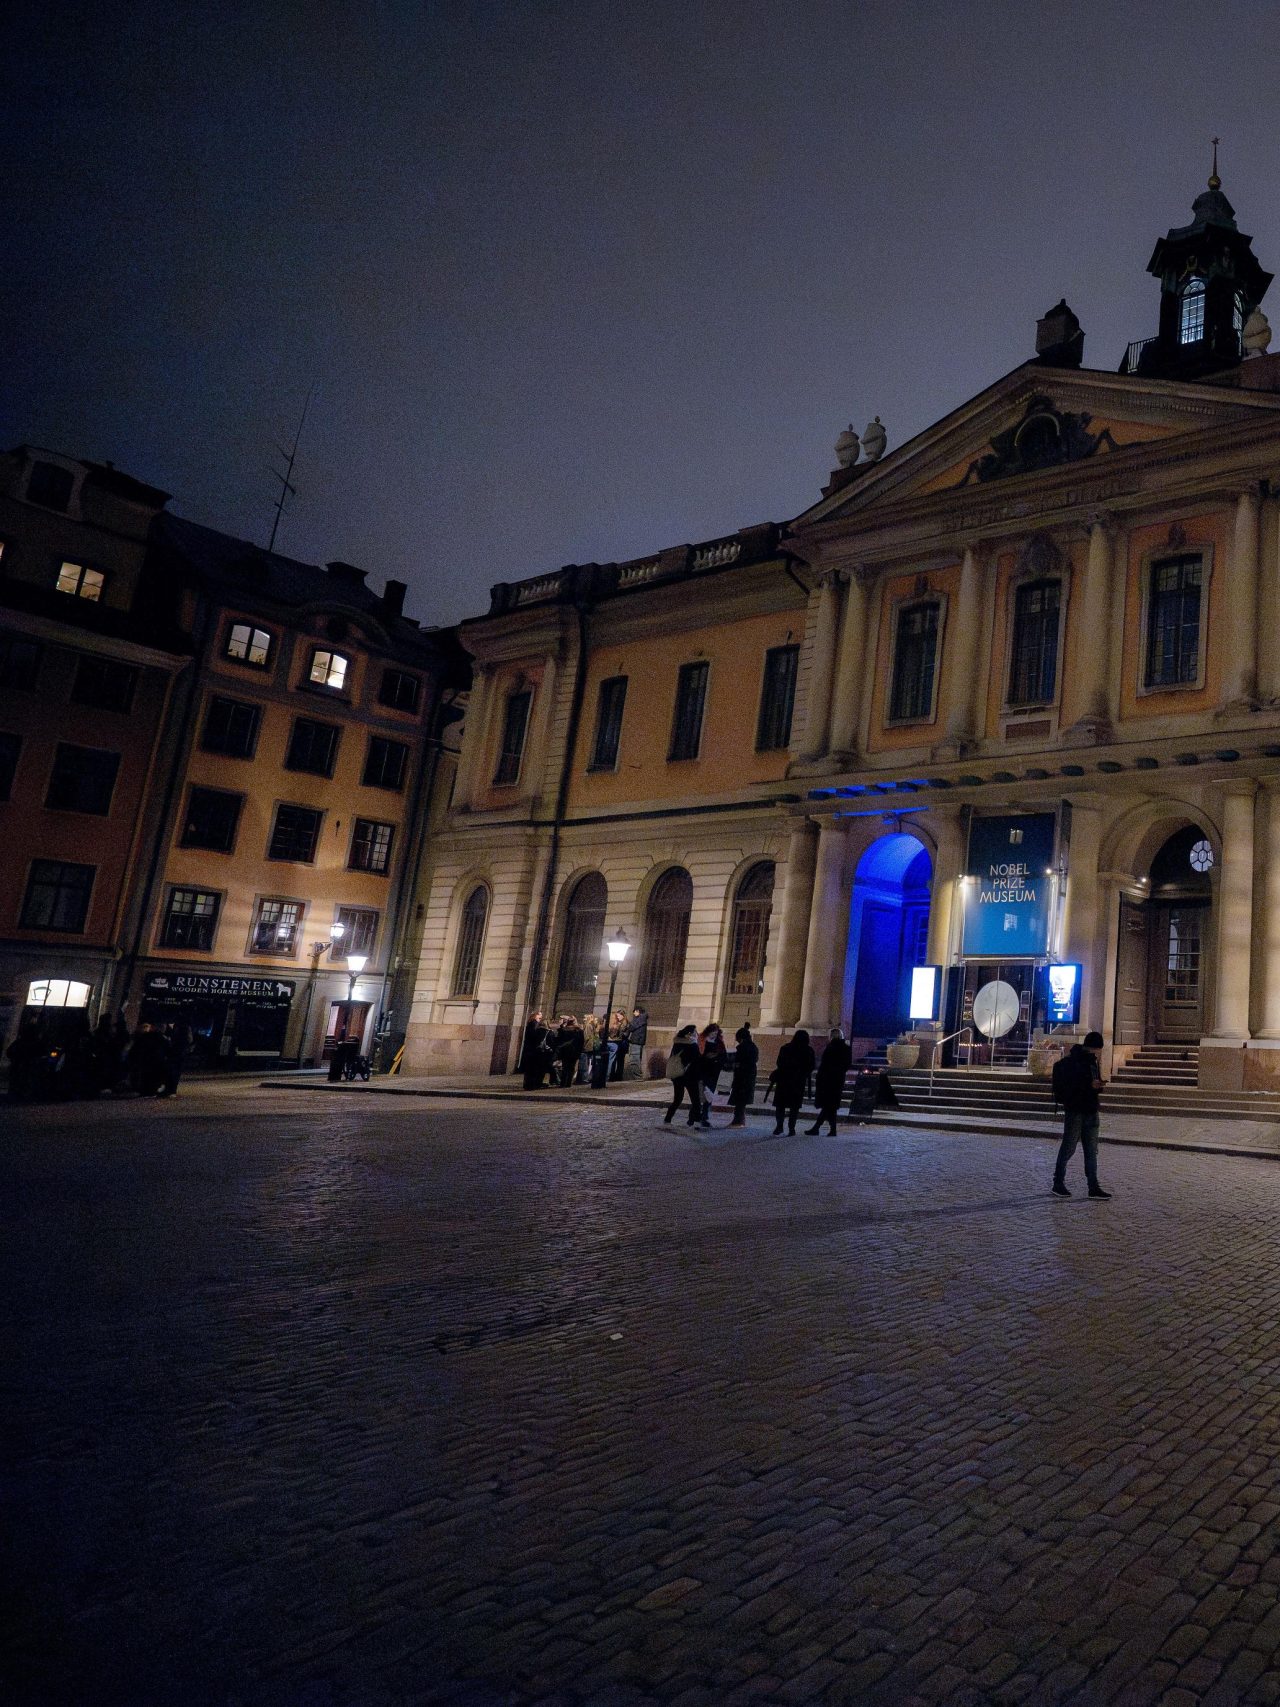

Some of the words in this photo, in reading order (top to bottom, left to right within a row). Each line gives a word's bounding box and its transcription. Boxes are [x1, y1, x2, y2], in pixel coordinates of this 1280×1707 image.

[990, 863, 1031, 876] NOBEL
[993, 877, 1025, 890] PRIZE
[980, 889, 1036, 903] MUSEUM
[176, 976, 273, 991] RUNSTENEN
